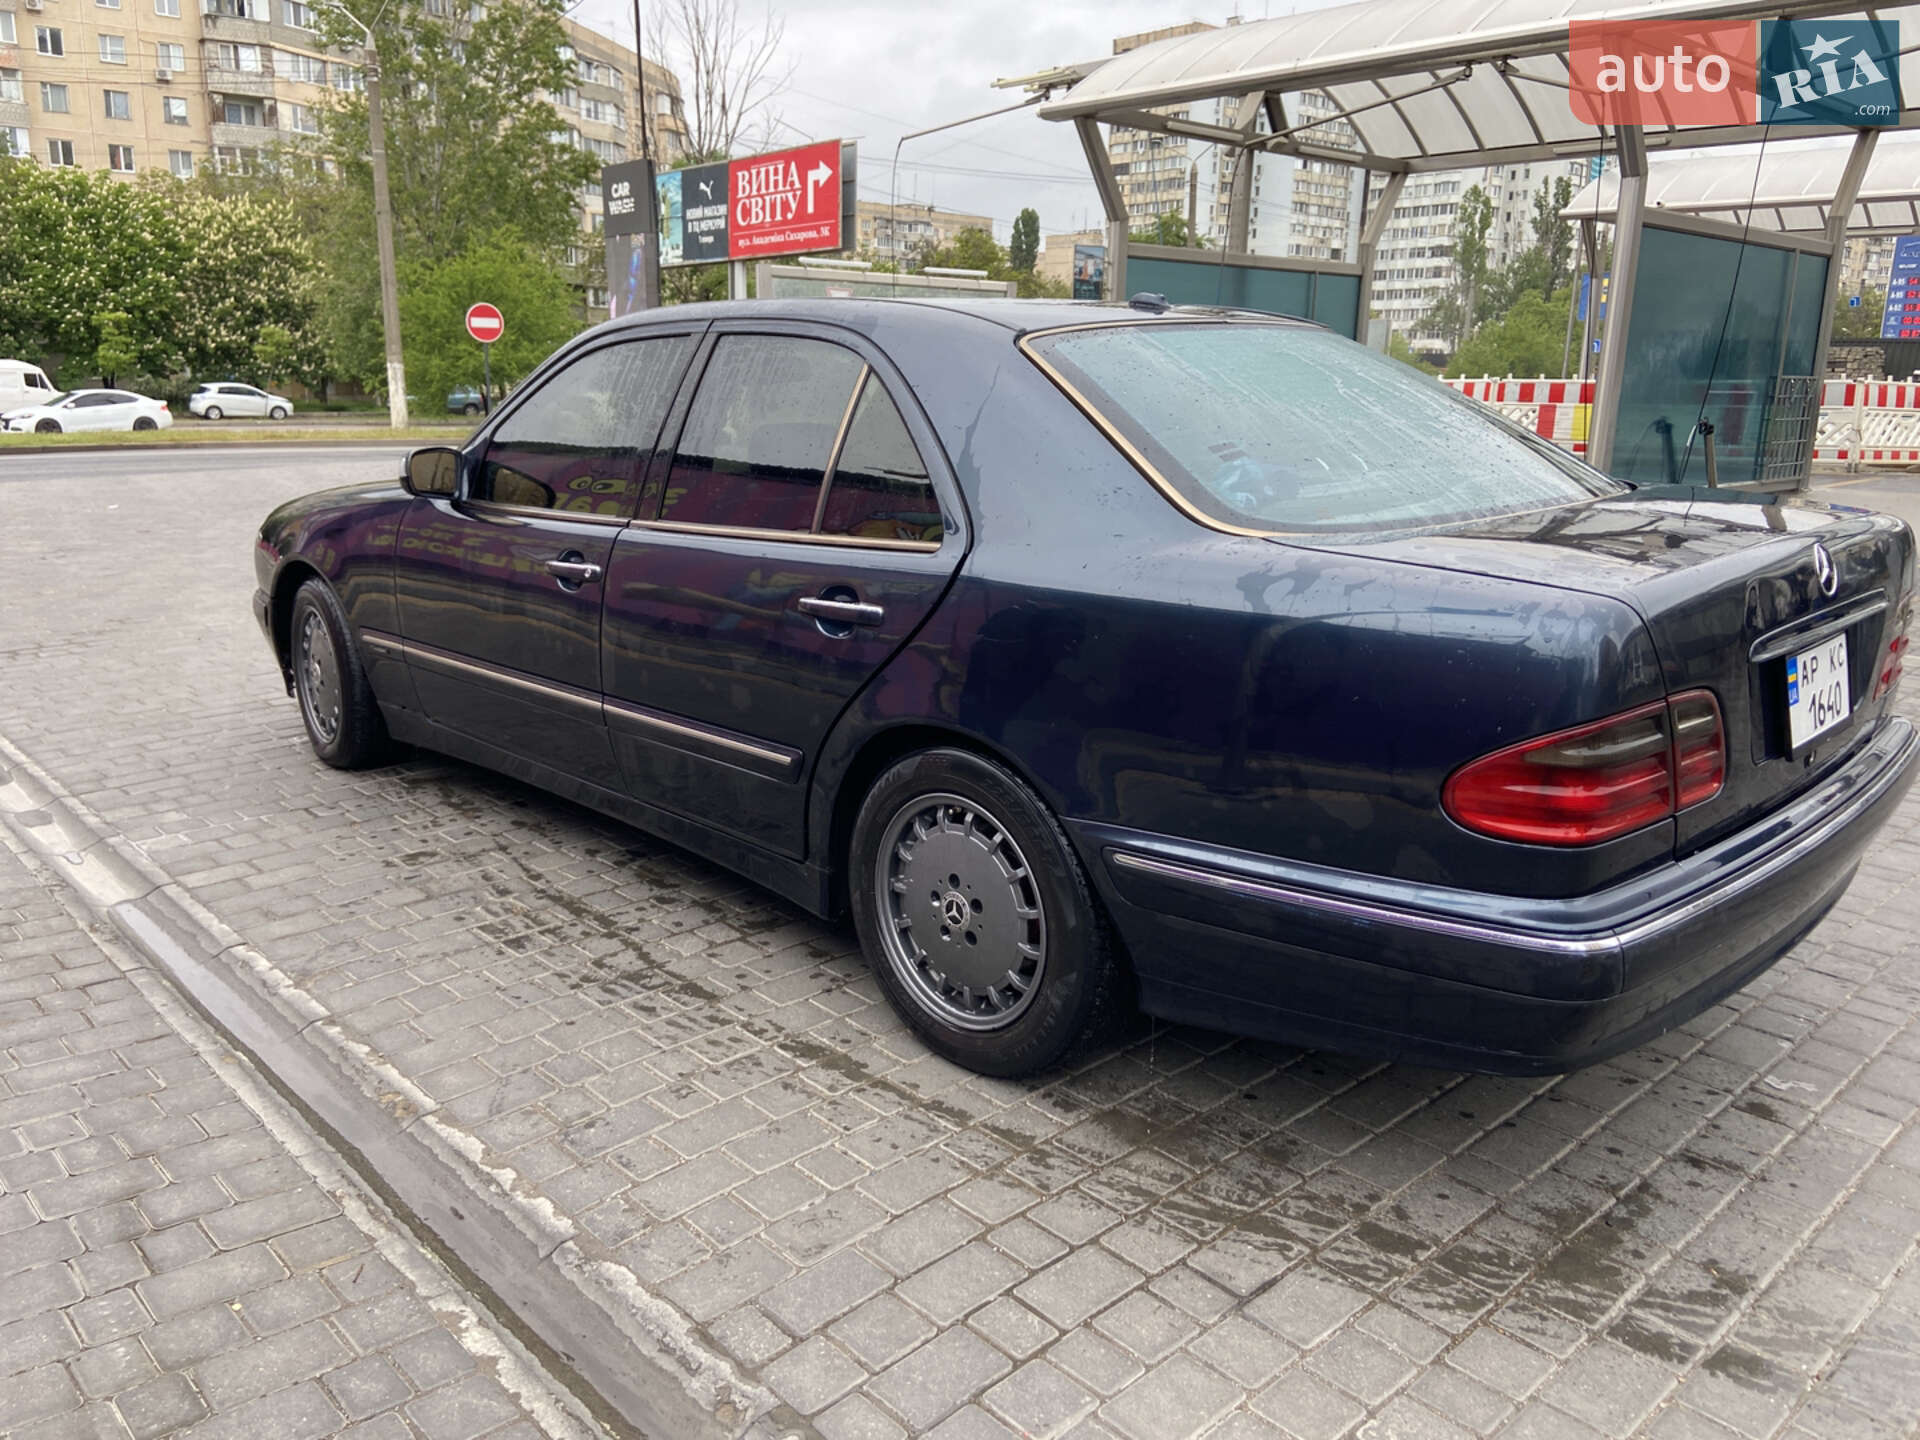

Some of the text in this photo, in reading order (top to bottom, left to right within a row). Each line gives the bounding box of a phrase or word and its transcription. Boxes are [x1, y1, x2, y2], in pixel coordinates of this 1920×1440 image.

[611, 182, 631, 199] CAR
[736, 160, 802, 199] ВИНА
[736, 190, 802, 227] СВІТУ
[1801, 642, 1844, 689] AP KC
[1809, 680, 1842, 730] 1640
